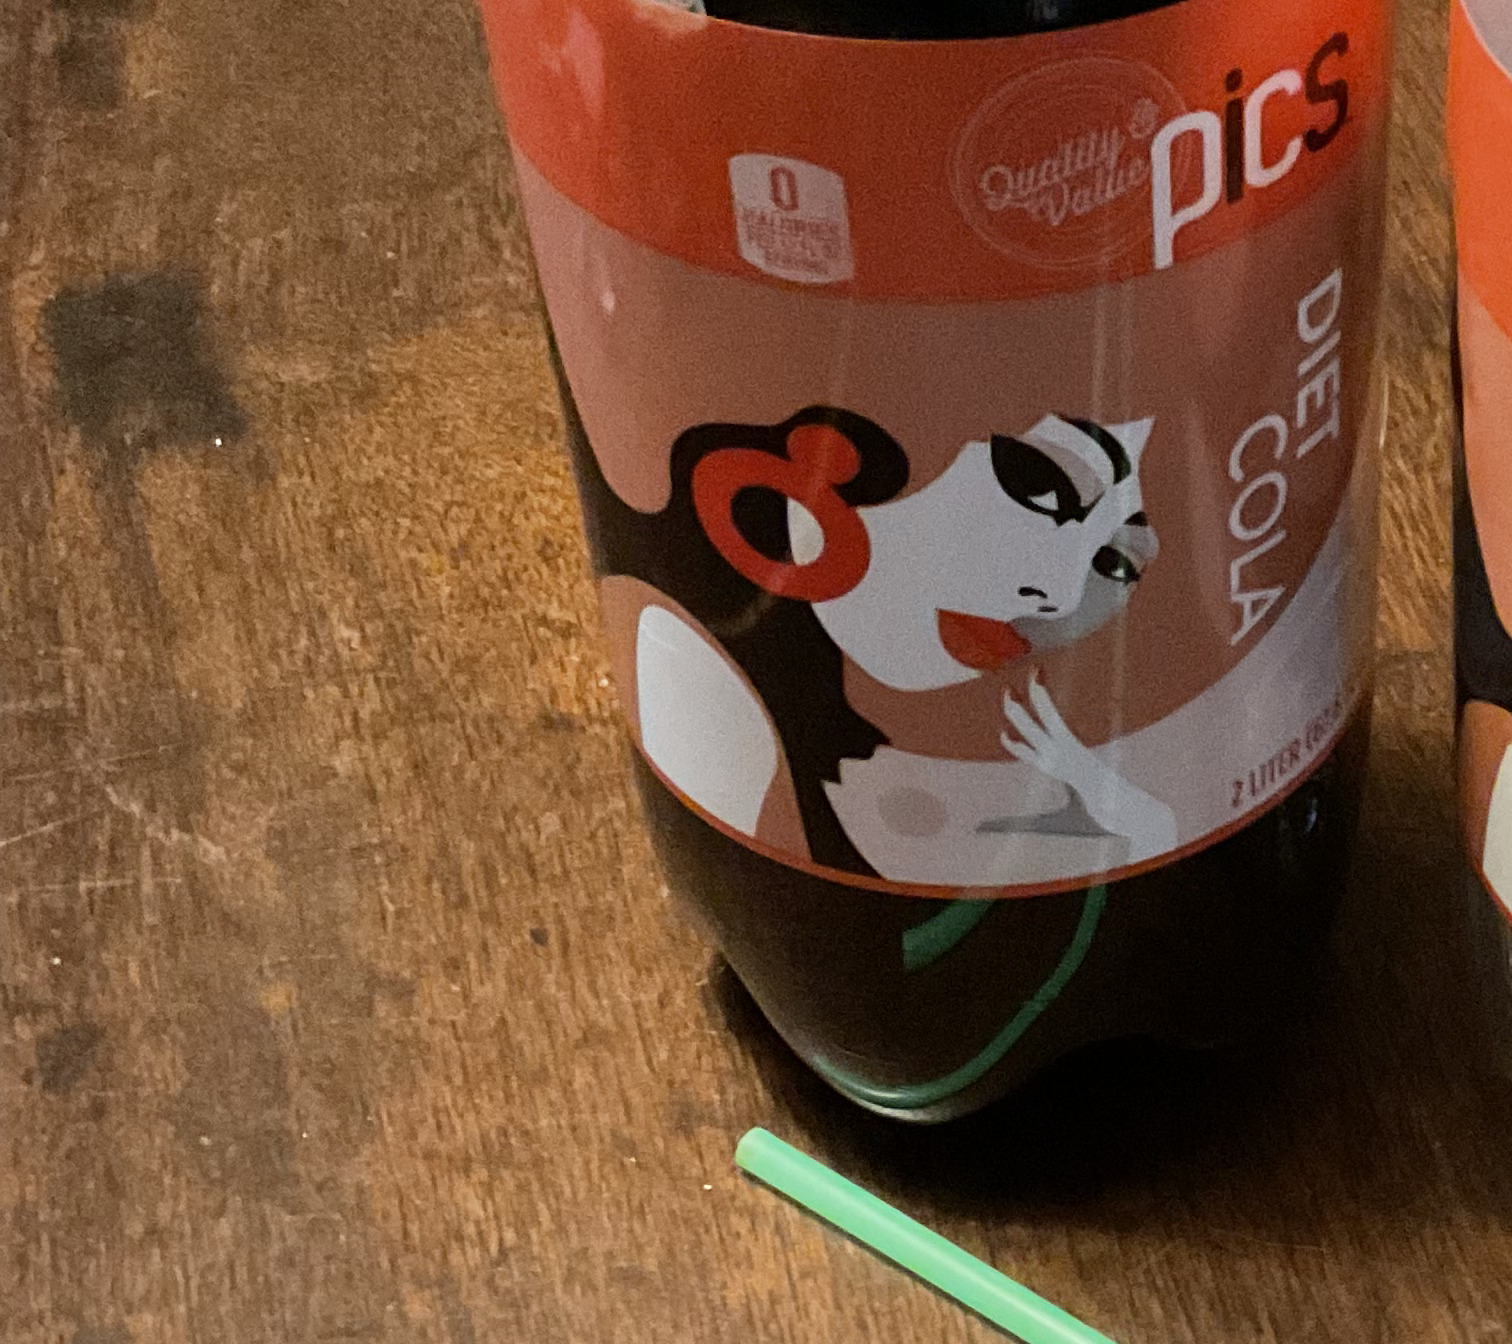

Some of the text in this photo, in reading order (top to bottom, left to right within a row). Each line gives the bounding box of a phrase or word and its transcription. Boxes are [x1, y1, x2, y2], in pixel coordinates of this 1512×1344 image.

[770, 166, 799, 211] 0
[980, 129, 1124, 211] Quality
[1151, 32, 1349, 269] pics
[1296, 267, 1343, 460] DIET
[1228, 414, 1289, 646] COLA
[1231, 779, 1244, 808] 2
[1248, 737, 1301, 797] LITER
